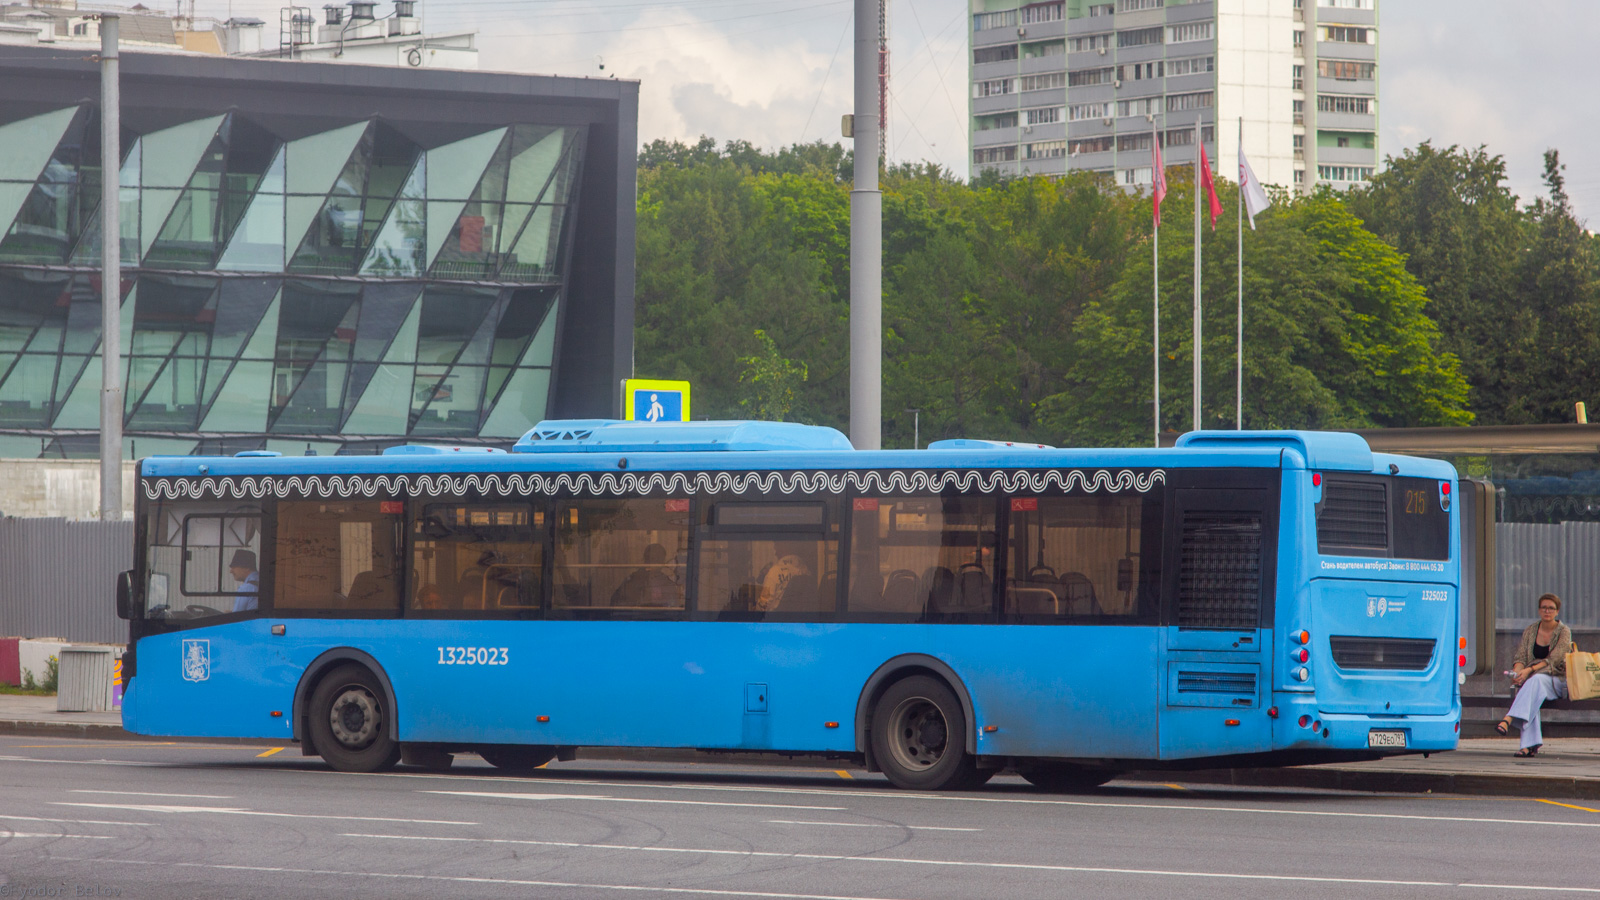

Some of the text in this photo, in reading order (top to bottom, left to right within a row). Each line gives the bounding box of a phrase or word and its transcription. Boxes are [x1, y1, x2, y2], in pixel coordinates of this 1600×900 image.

[1405, 490, 1426, 515] 215
[1321, 560, 1336, 570] Стань
[1336, 561, 1364, 571] водителем
[1364, 561, 1388, 571] автобуса!
[1405, 562, 1410, 571] 8
[1410, 562, 1420, 571] 800
[1420, 562, 1430, 571] 444
[1421, 590, 1448, 602] 1325023
[437, 646, 509, 666] 1325023
